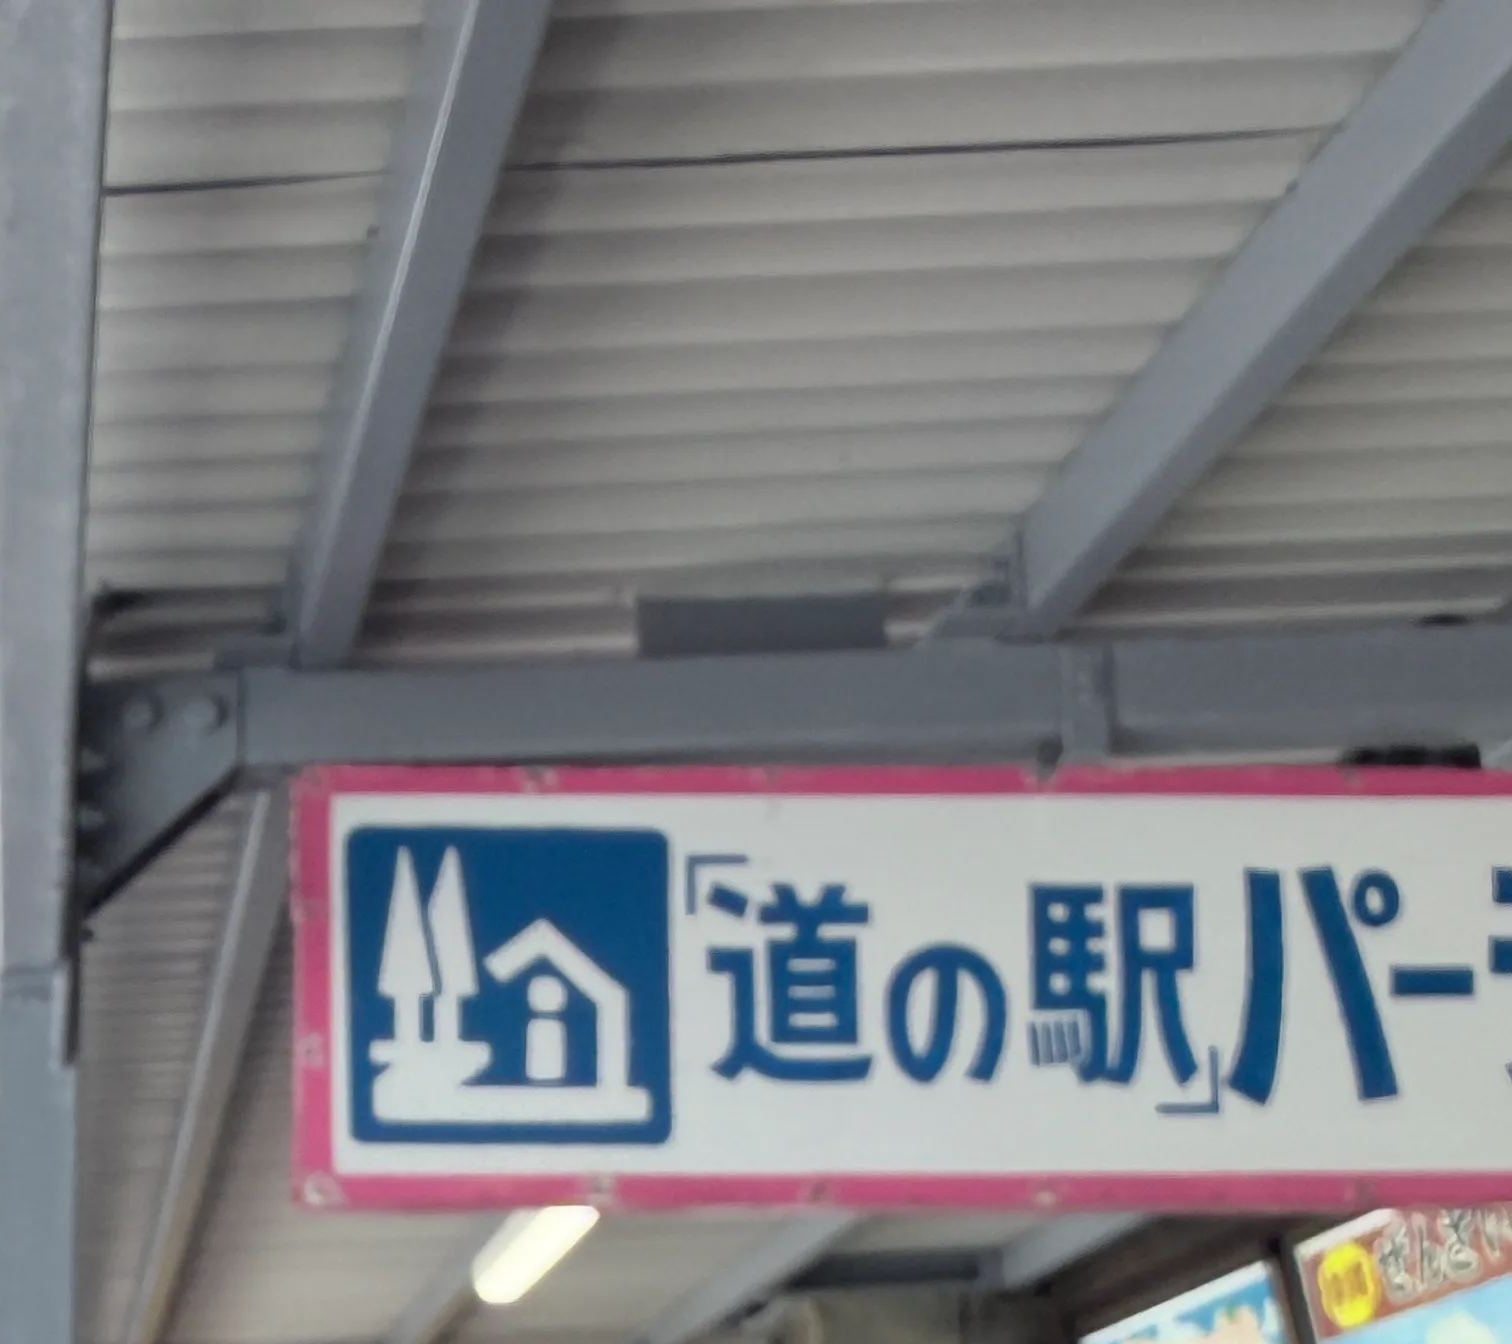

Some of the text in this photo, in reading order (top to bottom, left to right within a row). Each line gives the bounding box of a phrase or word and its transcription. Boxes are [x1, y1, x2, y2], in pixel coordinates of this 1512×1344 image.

[687, 853, 1512, 1113] 「道の駅」パー
